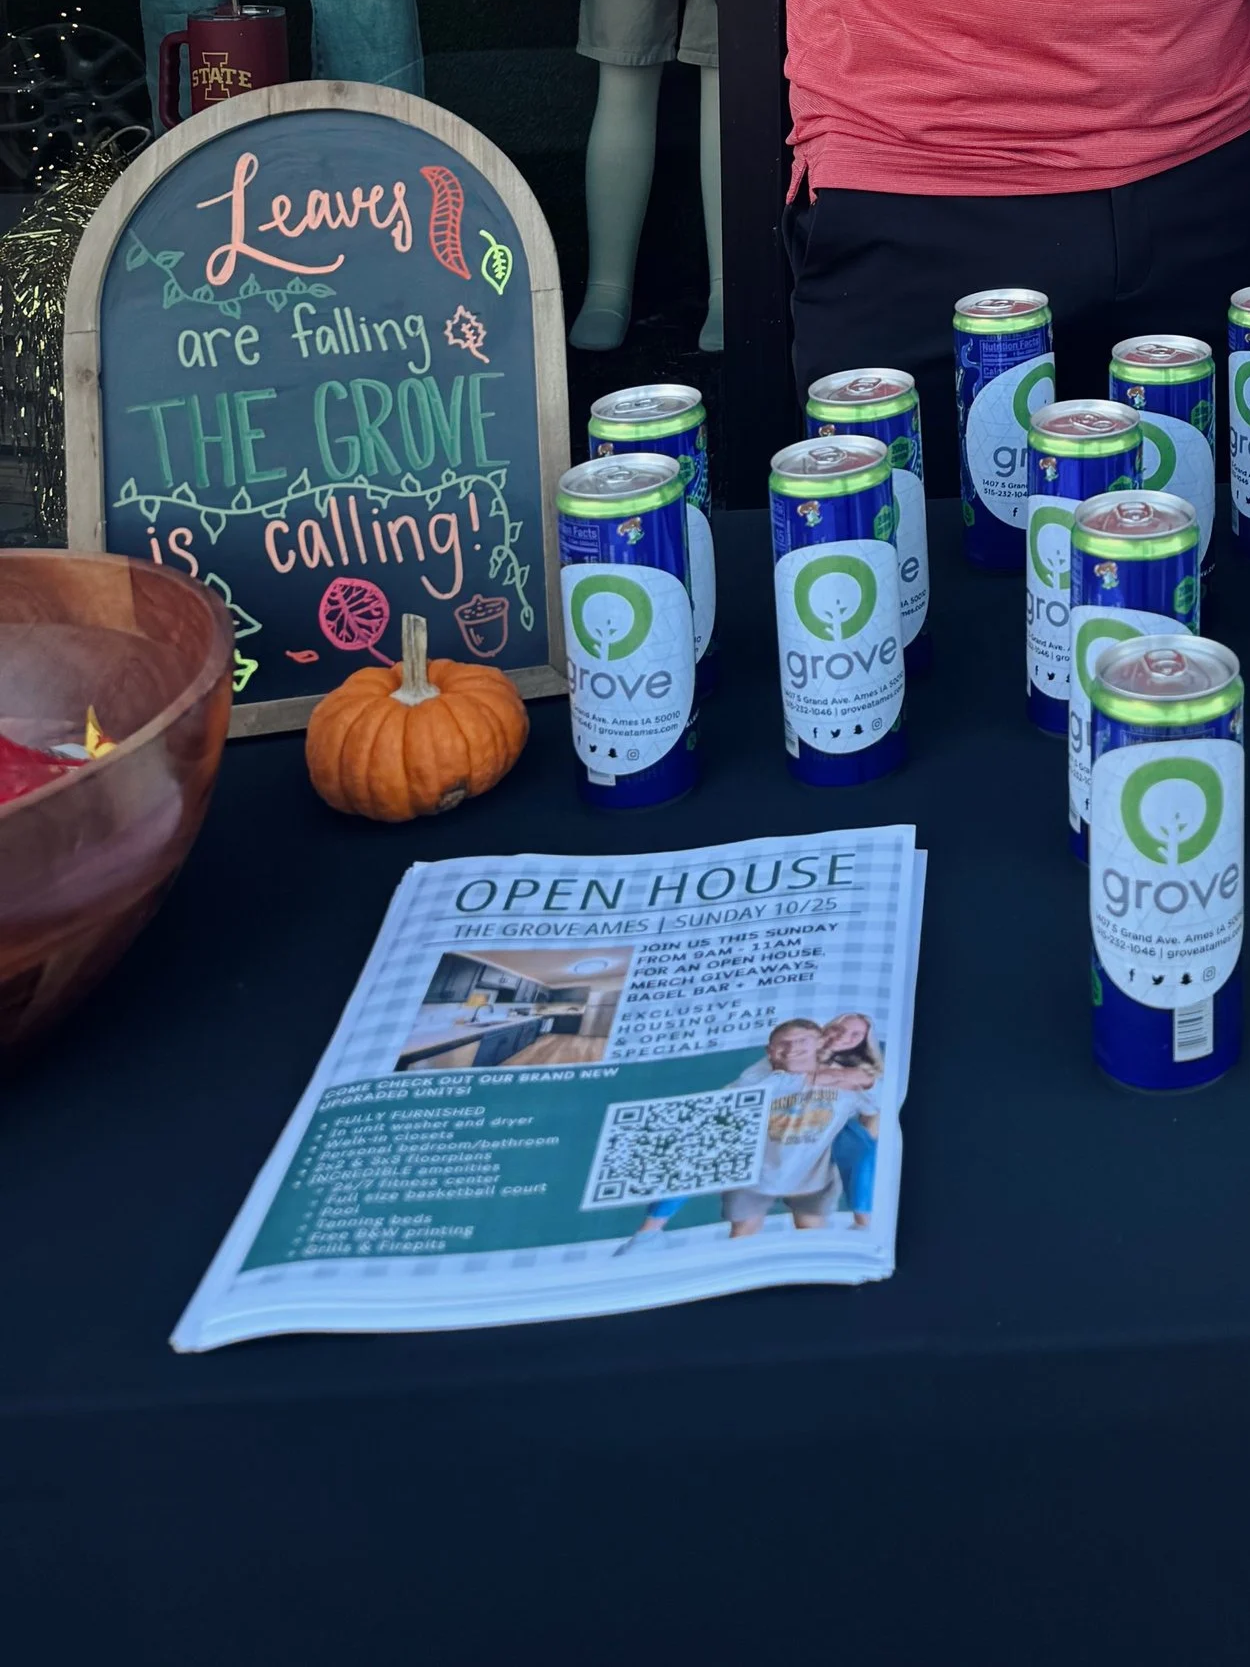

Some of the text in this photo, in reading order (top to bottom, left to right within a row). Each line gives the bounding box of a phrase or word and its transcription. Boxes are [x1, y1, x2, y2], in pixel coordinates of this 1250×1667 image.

[191, 67, 252, 89] STATE
[196, 152, 413, 286] Leaves
[177, 301, 431, 374] are falling
[125, 372, 511, 489] THE GROVE
[149, 491, 483, 600] is calling!
[568, 658, 673, 702] grove
[787, 636, 897, 689] grove
[803, 696, 828, 706] Grand
[854, 689, 878, 702] Ames
[612, 717, 638, 726] Ames
[455, 853, 856, 913] OPEN HOUSE
[1102, 862, 1239, 917] grove
[454, 923, 496, 939] THE
[502, 921, 580, 937] GROVE
[585, 919, 649, 935] AMES
[675, 904, 768, 929] SUNDAY
[775, 897, 838, 916] 10/25
[1121, 927, 1152, 943] Grand
[1185, 931, 1213, 943] Ames
[637, 938, 801, 965] FROM 9AM 11AM
[640, 922, 839, 952] JOIN US THIS SUNDAY
[630, 976, 694, 990] MERCH
[633, 966, 668, 977] FOR
[674, 962, 700, 973] AN
[707, 956, 755, 969] OPEN
[626, 990, 686, 1003] BAGEL
[693, 984, 729, 995] BAR
